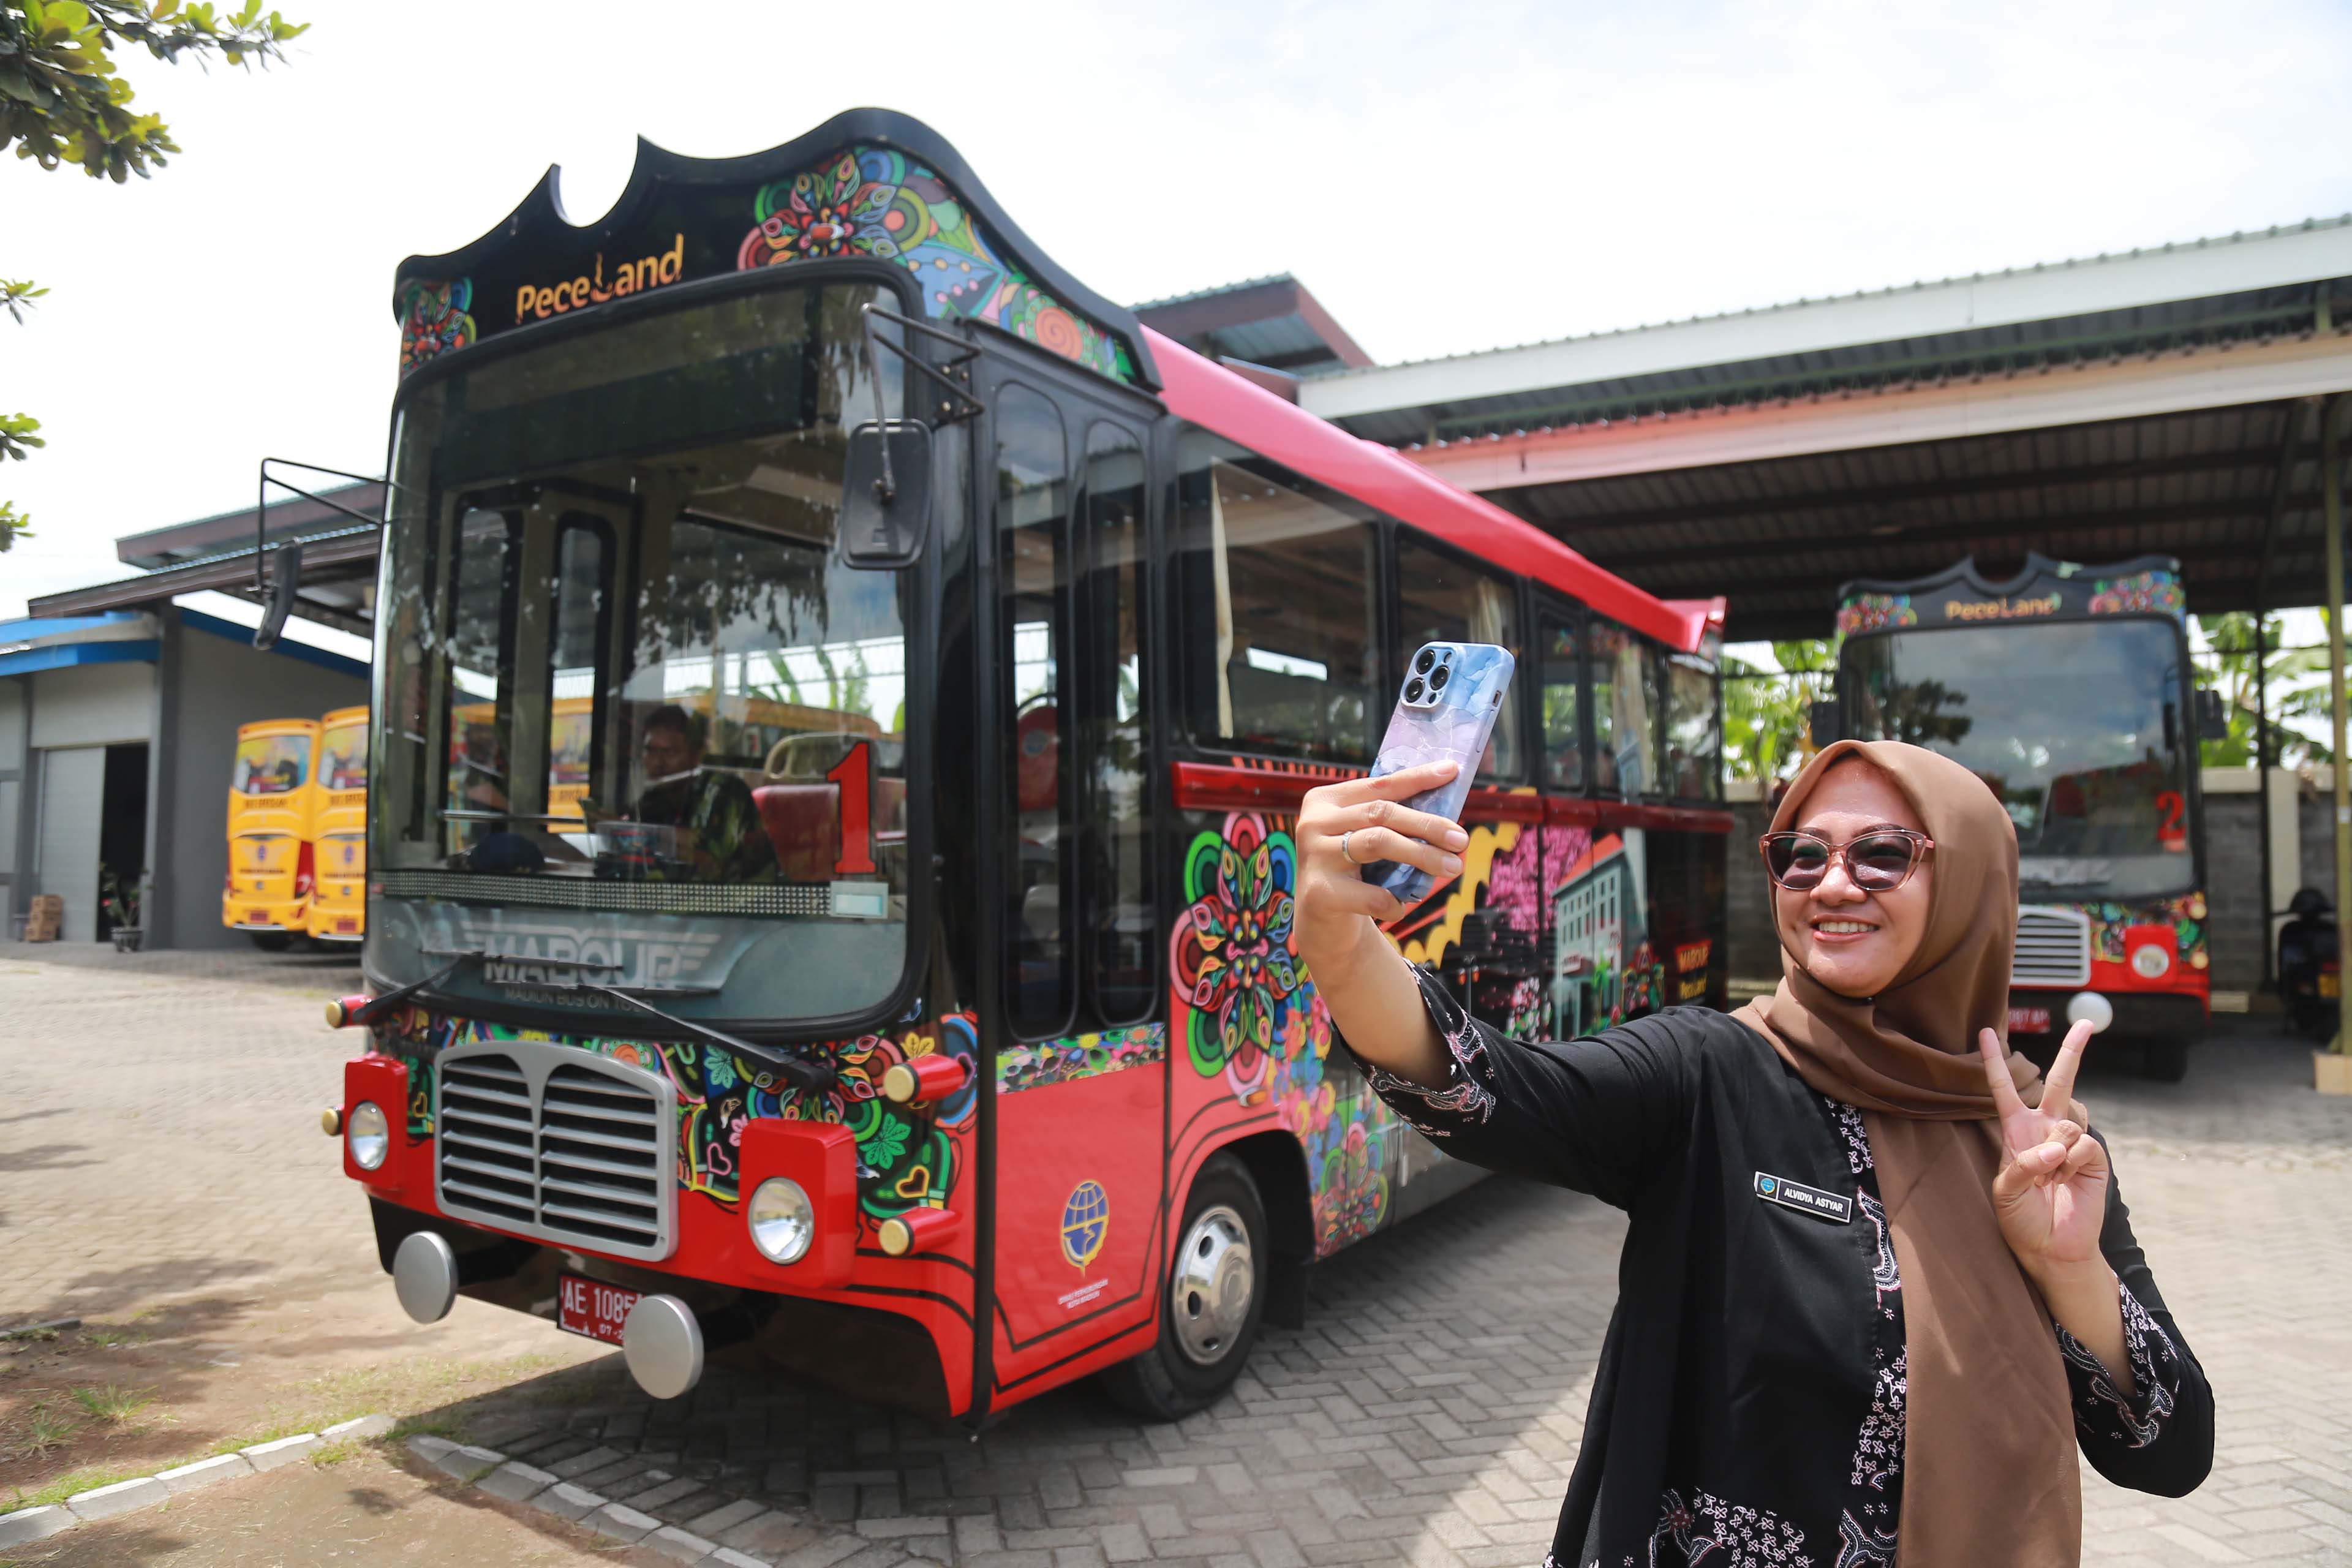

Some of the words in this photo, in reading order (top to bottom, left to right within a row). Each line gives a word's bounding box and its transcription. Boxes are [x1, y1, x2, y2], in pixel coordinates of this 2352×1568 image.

[826, 741, 876, 874] 1
[2155, 791, 2186, 840] 2
[556, 990, 586, 1006] BUS
[587, 993, 610, 1009] ON
[1784, 1188, 1813, 1204] ALVIDYA
[1815, 1197, 1843, 1213] ASTYAR
[564, 1281, 586, 1314] AE
